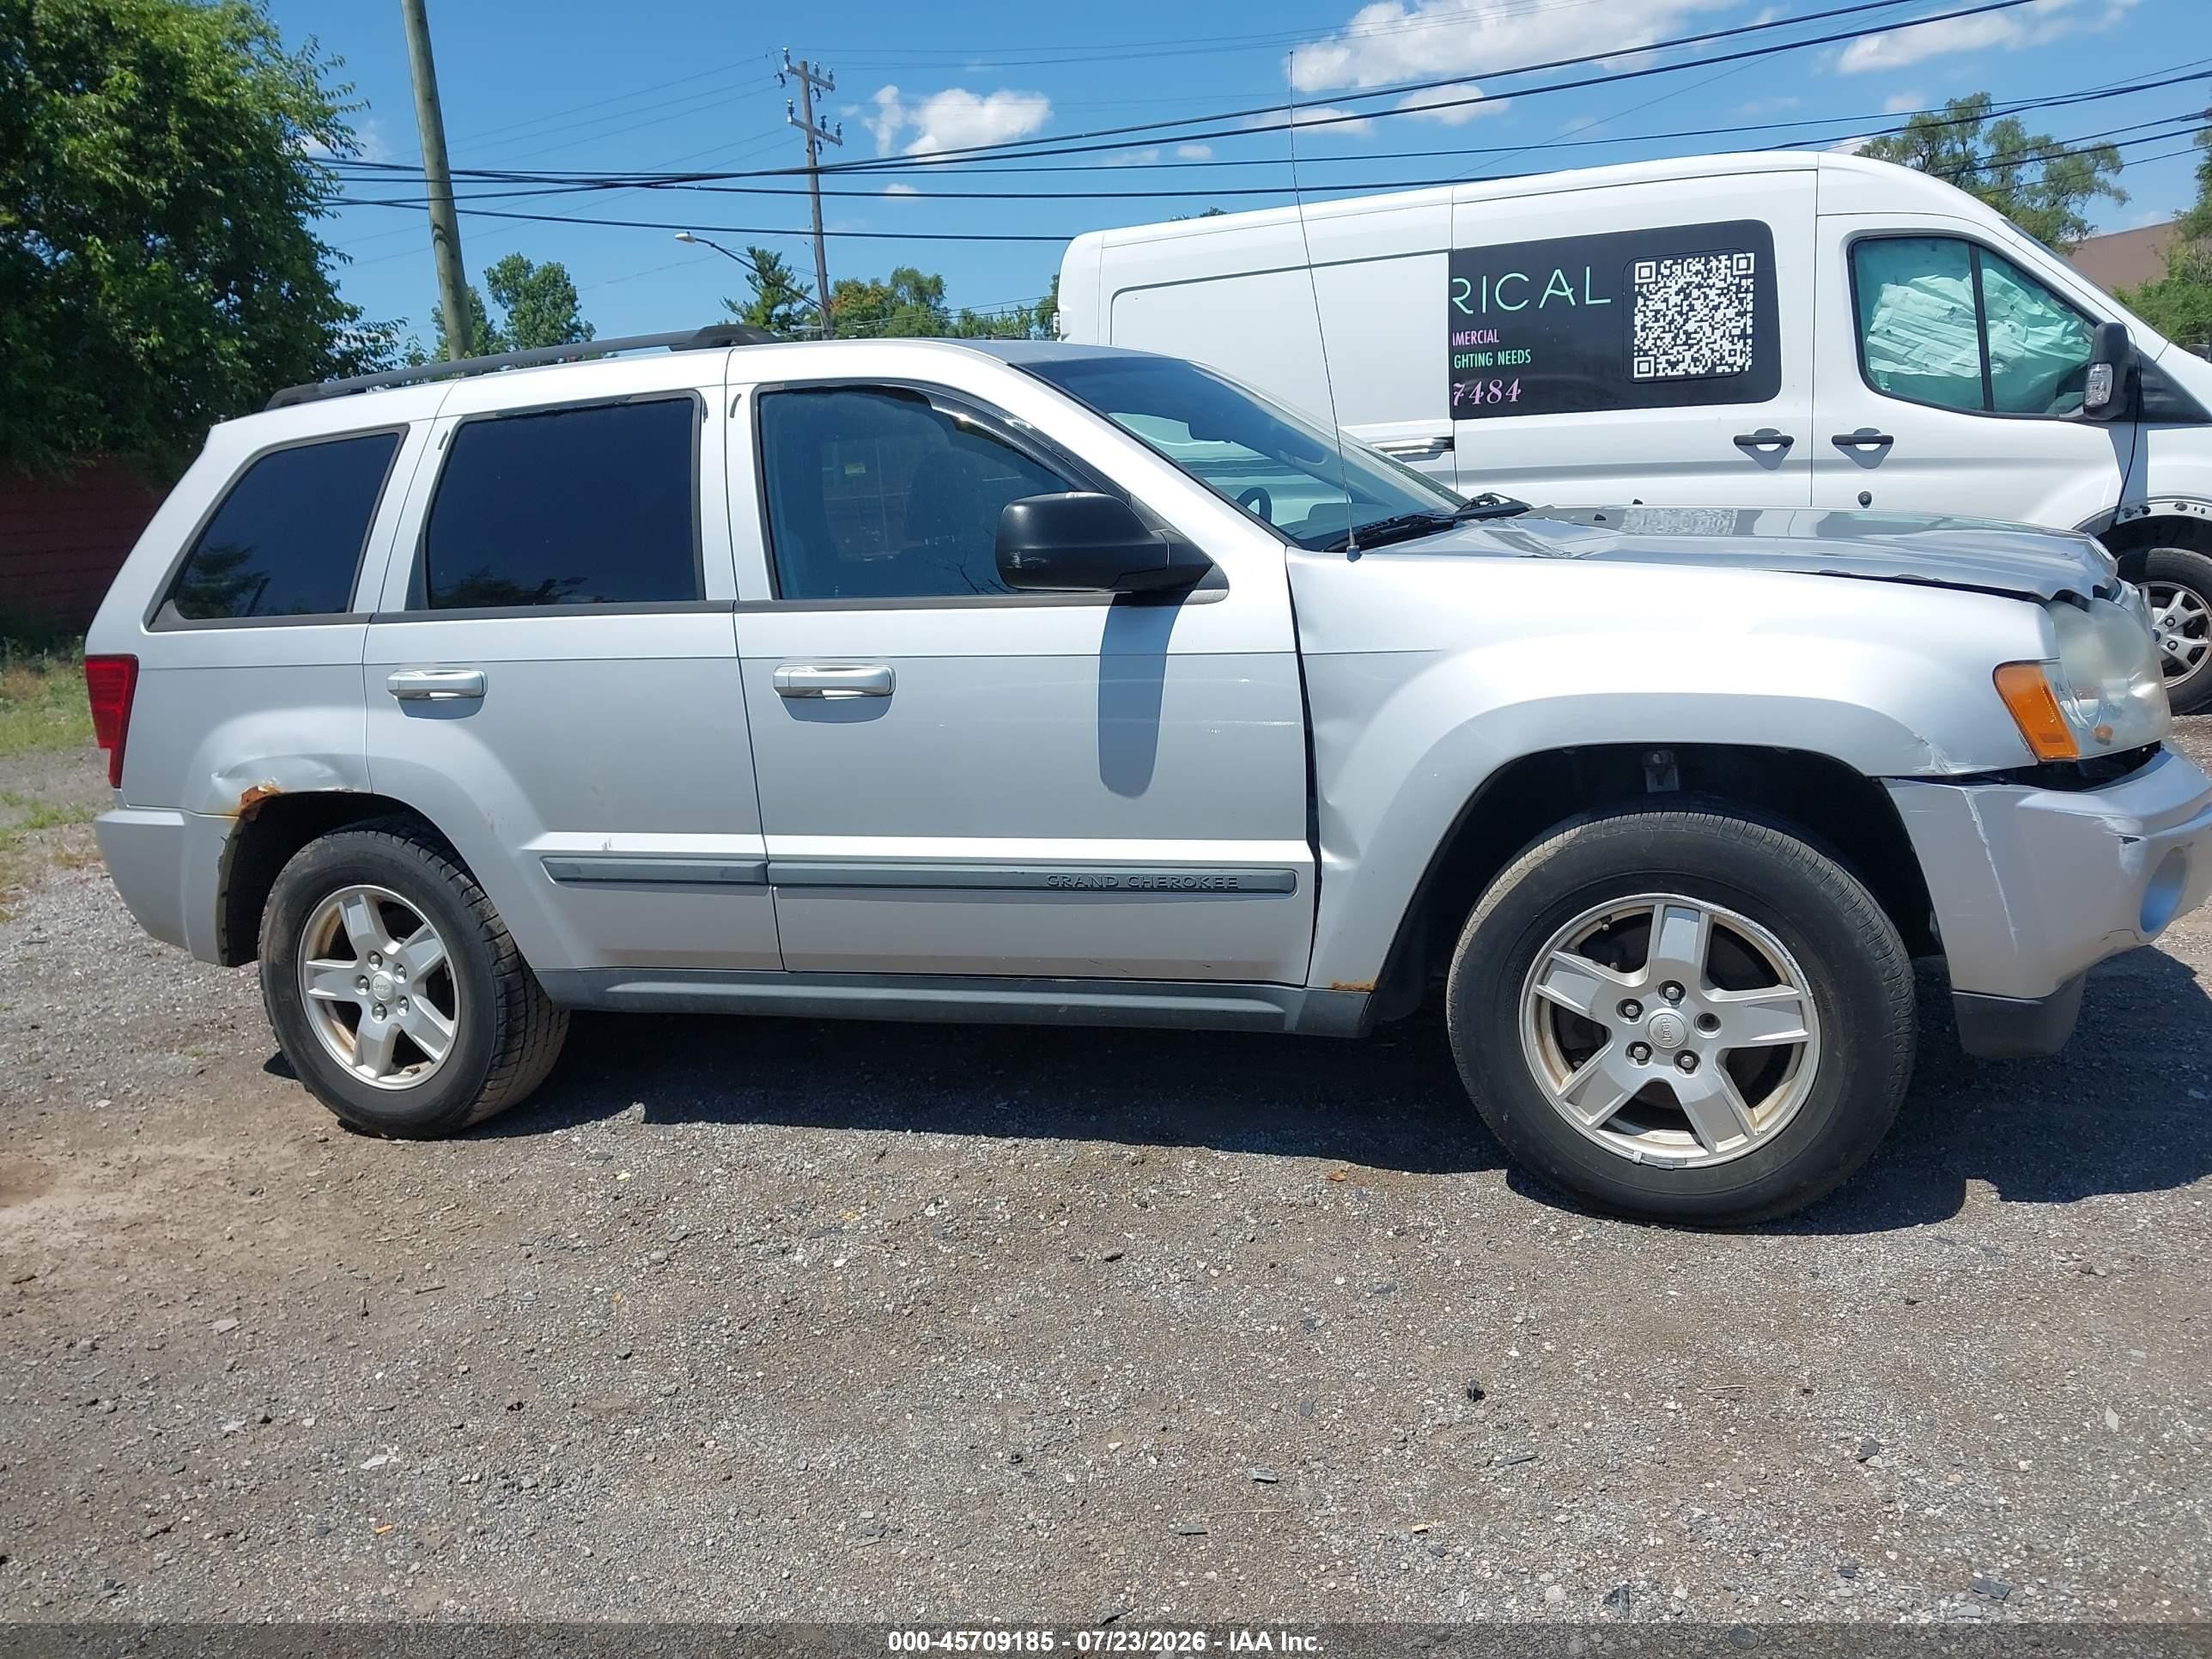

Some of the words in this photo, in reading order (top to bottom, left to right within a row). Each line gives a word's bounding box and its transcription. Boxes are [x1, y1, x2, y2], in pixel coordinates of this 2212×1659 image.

[1452, 266, 1612, 314] RICAL
[1454, 352, 1493, 368] GHTING
[1498, 349, 1532, 366] NEEDS
[1452, 378, 1522, 406] 7484
[1047, 874, 1120, 888] GRAND
[1127, 875, 1238, 889] CHEROKEE
